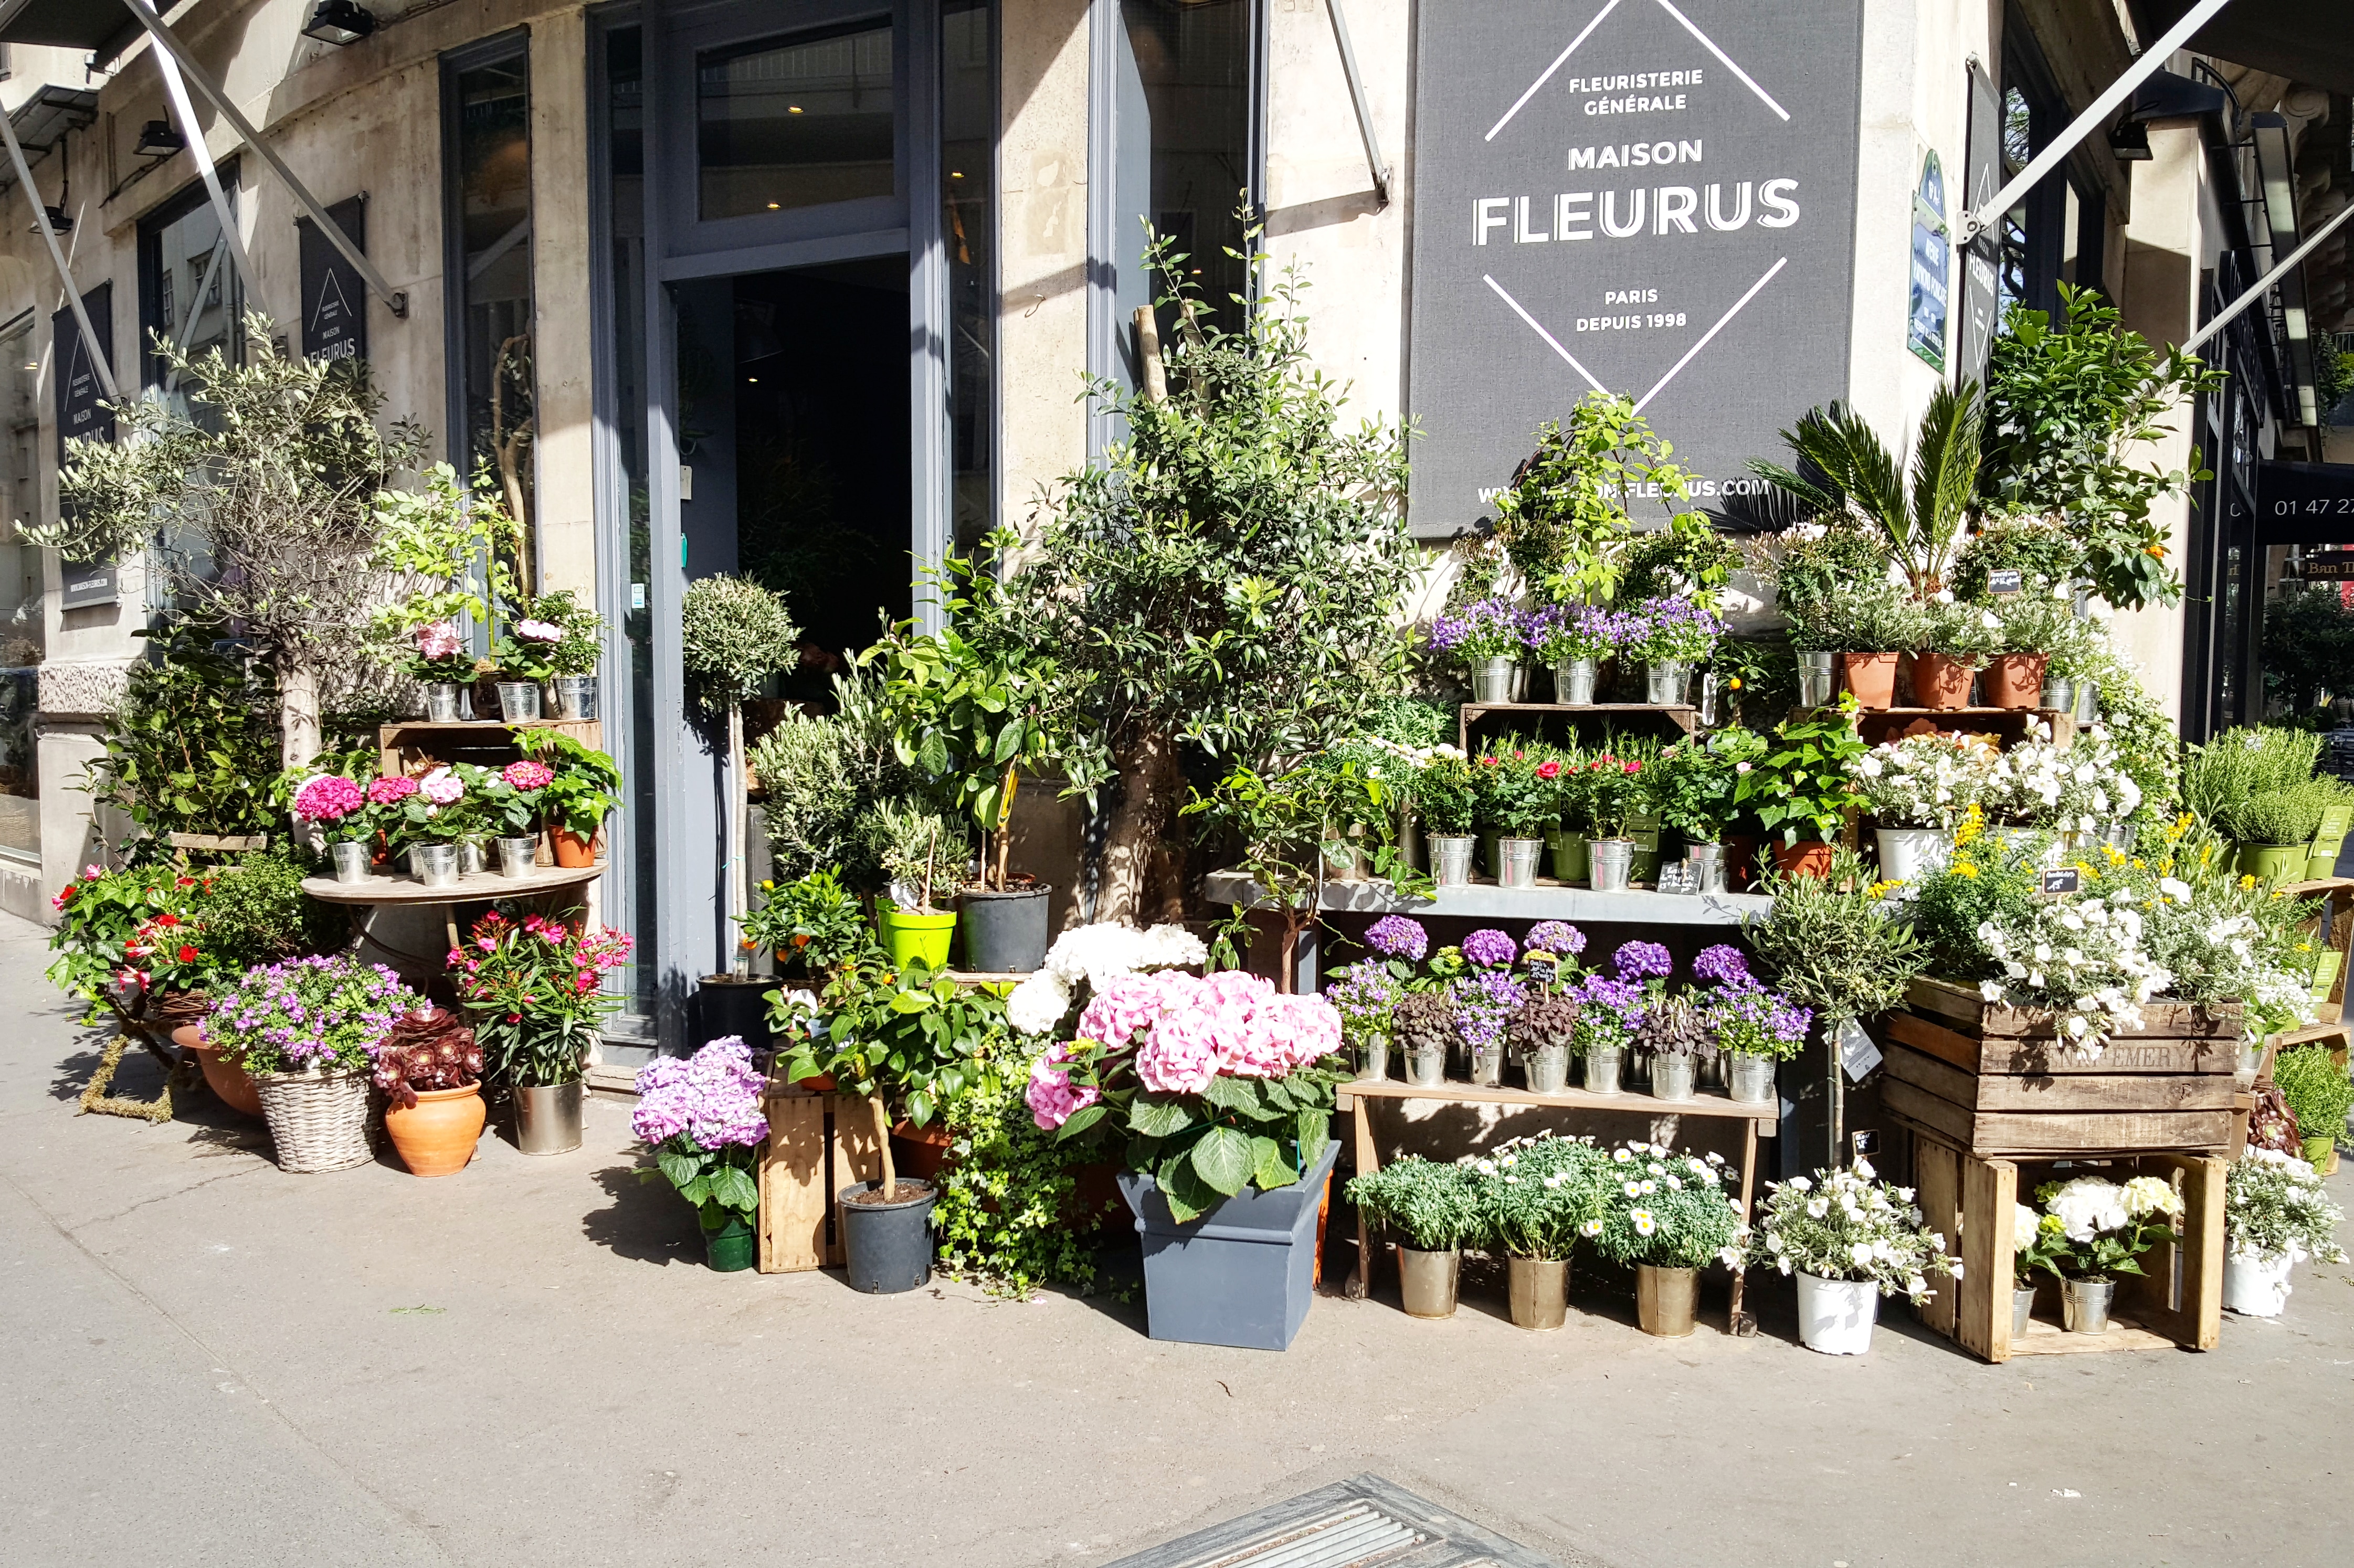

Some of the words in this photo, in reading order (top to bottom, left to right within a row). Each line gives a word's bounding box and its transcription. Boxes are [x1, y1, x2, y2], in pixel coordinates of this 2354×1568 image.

[1569, 69, 1703, 93] FLEURISTERIE
[1584, 94, 1686, 115] GÉNÉRALE
[1568, 139, 1702, 171] MAISON
[1473, 178, 1800, 246] FLEURUS
[1969, 248, 1994, 297] FLEURUS
[1605, 289, 1658, 305] PARIS
[1576, 315, 1641, 332] DEPUIS
[1646, 312, 1686, 328] 1998
[323, 326, 340, 340] MAISON
[2275, 500, 2296, 515] 01
[2305, 499, 2330, 514] 47
[2307, 562, 2338, 574] Ban
